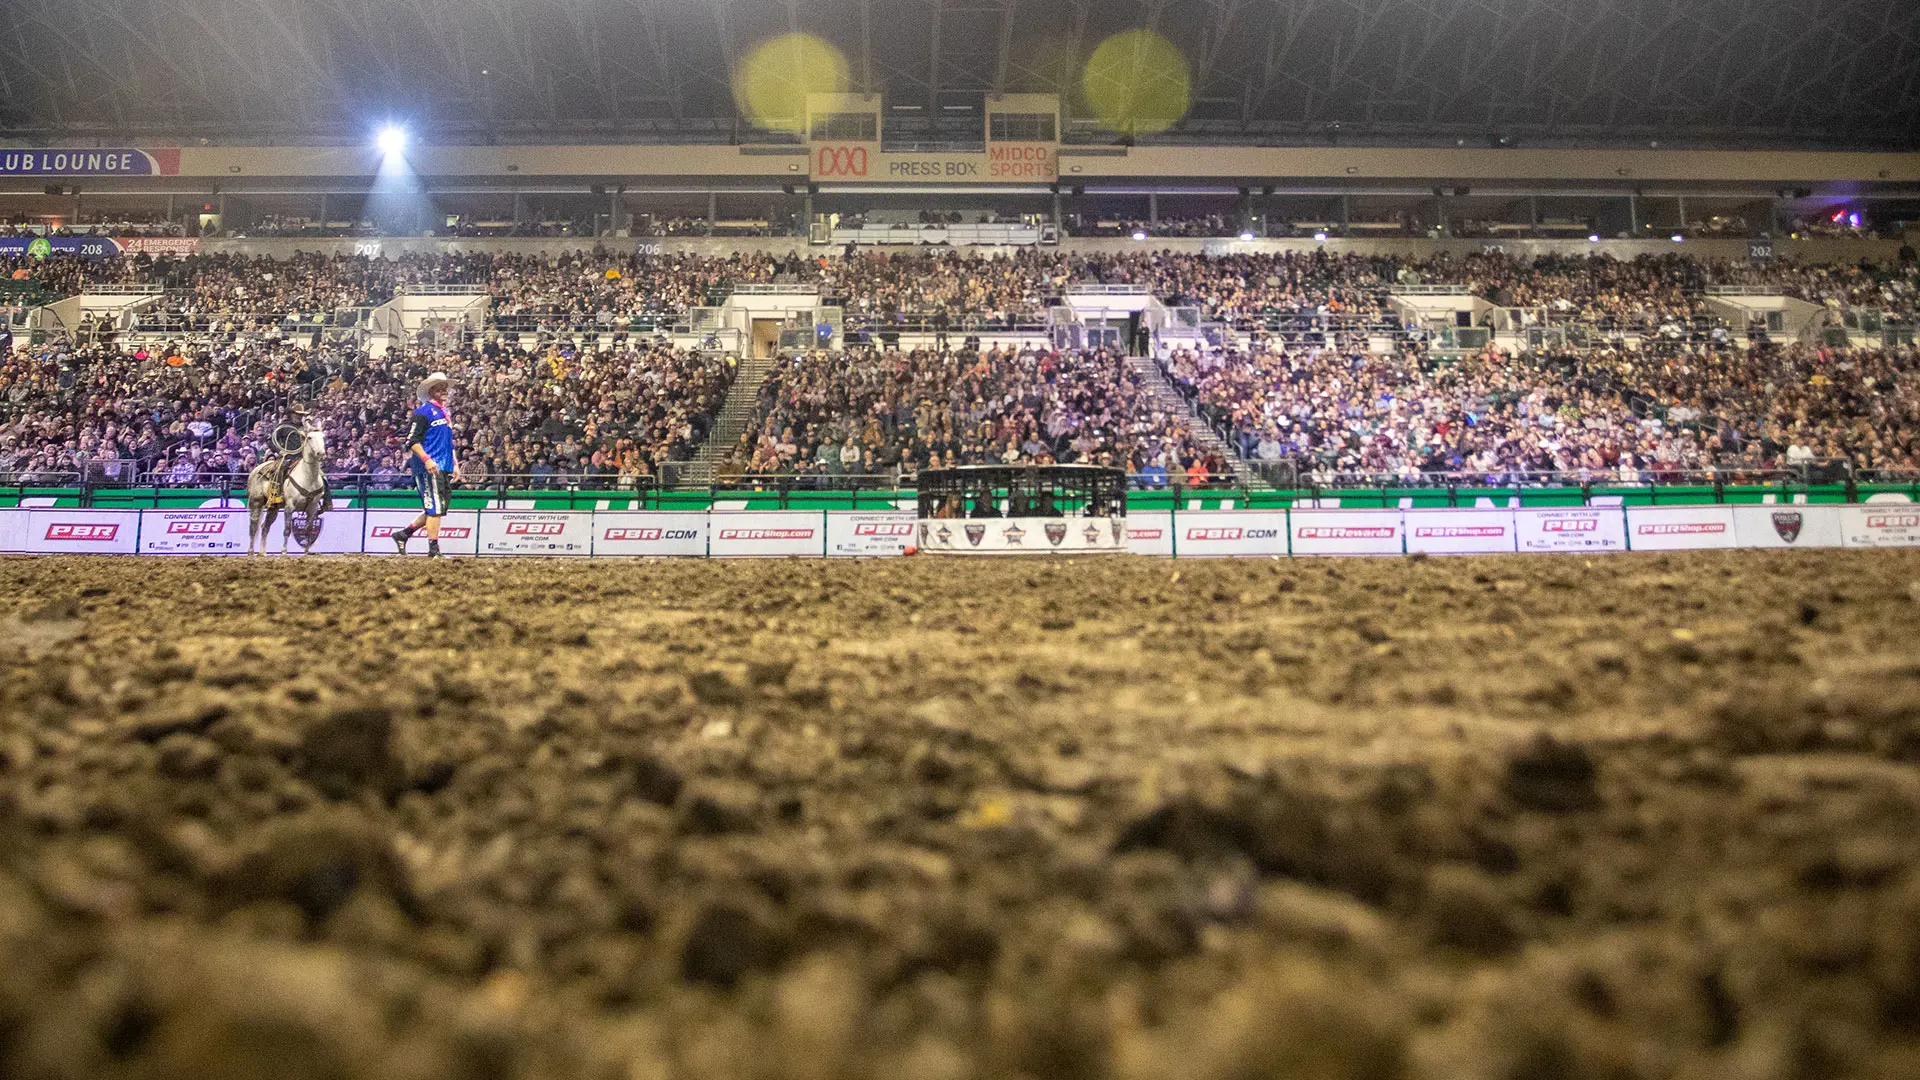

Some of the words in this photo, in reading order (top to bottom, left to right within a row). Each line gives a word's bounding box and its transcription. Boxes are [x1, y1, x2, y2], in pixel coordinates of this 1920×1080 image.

[991, 147, 1047, 160] MIDCO
[0, 154, 35, 171] UB
[42, 154, 133, 171] LOUNGE
[889, 161, 941, 176] PRESS
[945, 161, 977, 176] BOX
[990, 163, 1055, 177] SPORTS
[80, 244, 103, 255] 208
[143, 245, 191, 253] RESPONSE
[355, 244, 380, 255] 207
[638, 243, 661, 255] 206
[1750, 245, 1773, 257] 202
[50, 525, 115, 537] PBR
[170, 522, 221, 533] PBR
[509, 523, 561, 534] PBR
[857, 524, 909, 535] PBR
[1545, 520, 1596, 531] PBR
[606, 528, 698, 540] PBR.COM
[1189, 528, 1278, 540] PBR.COM
